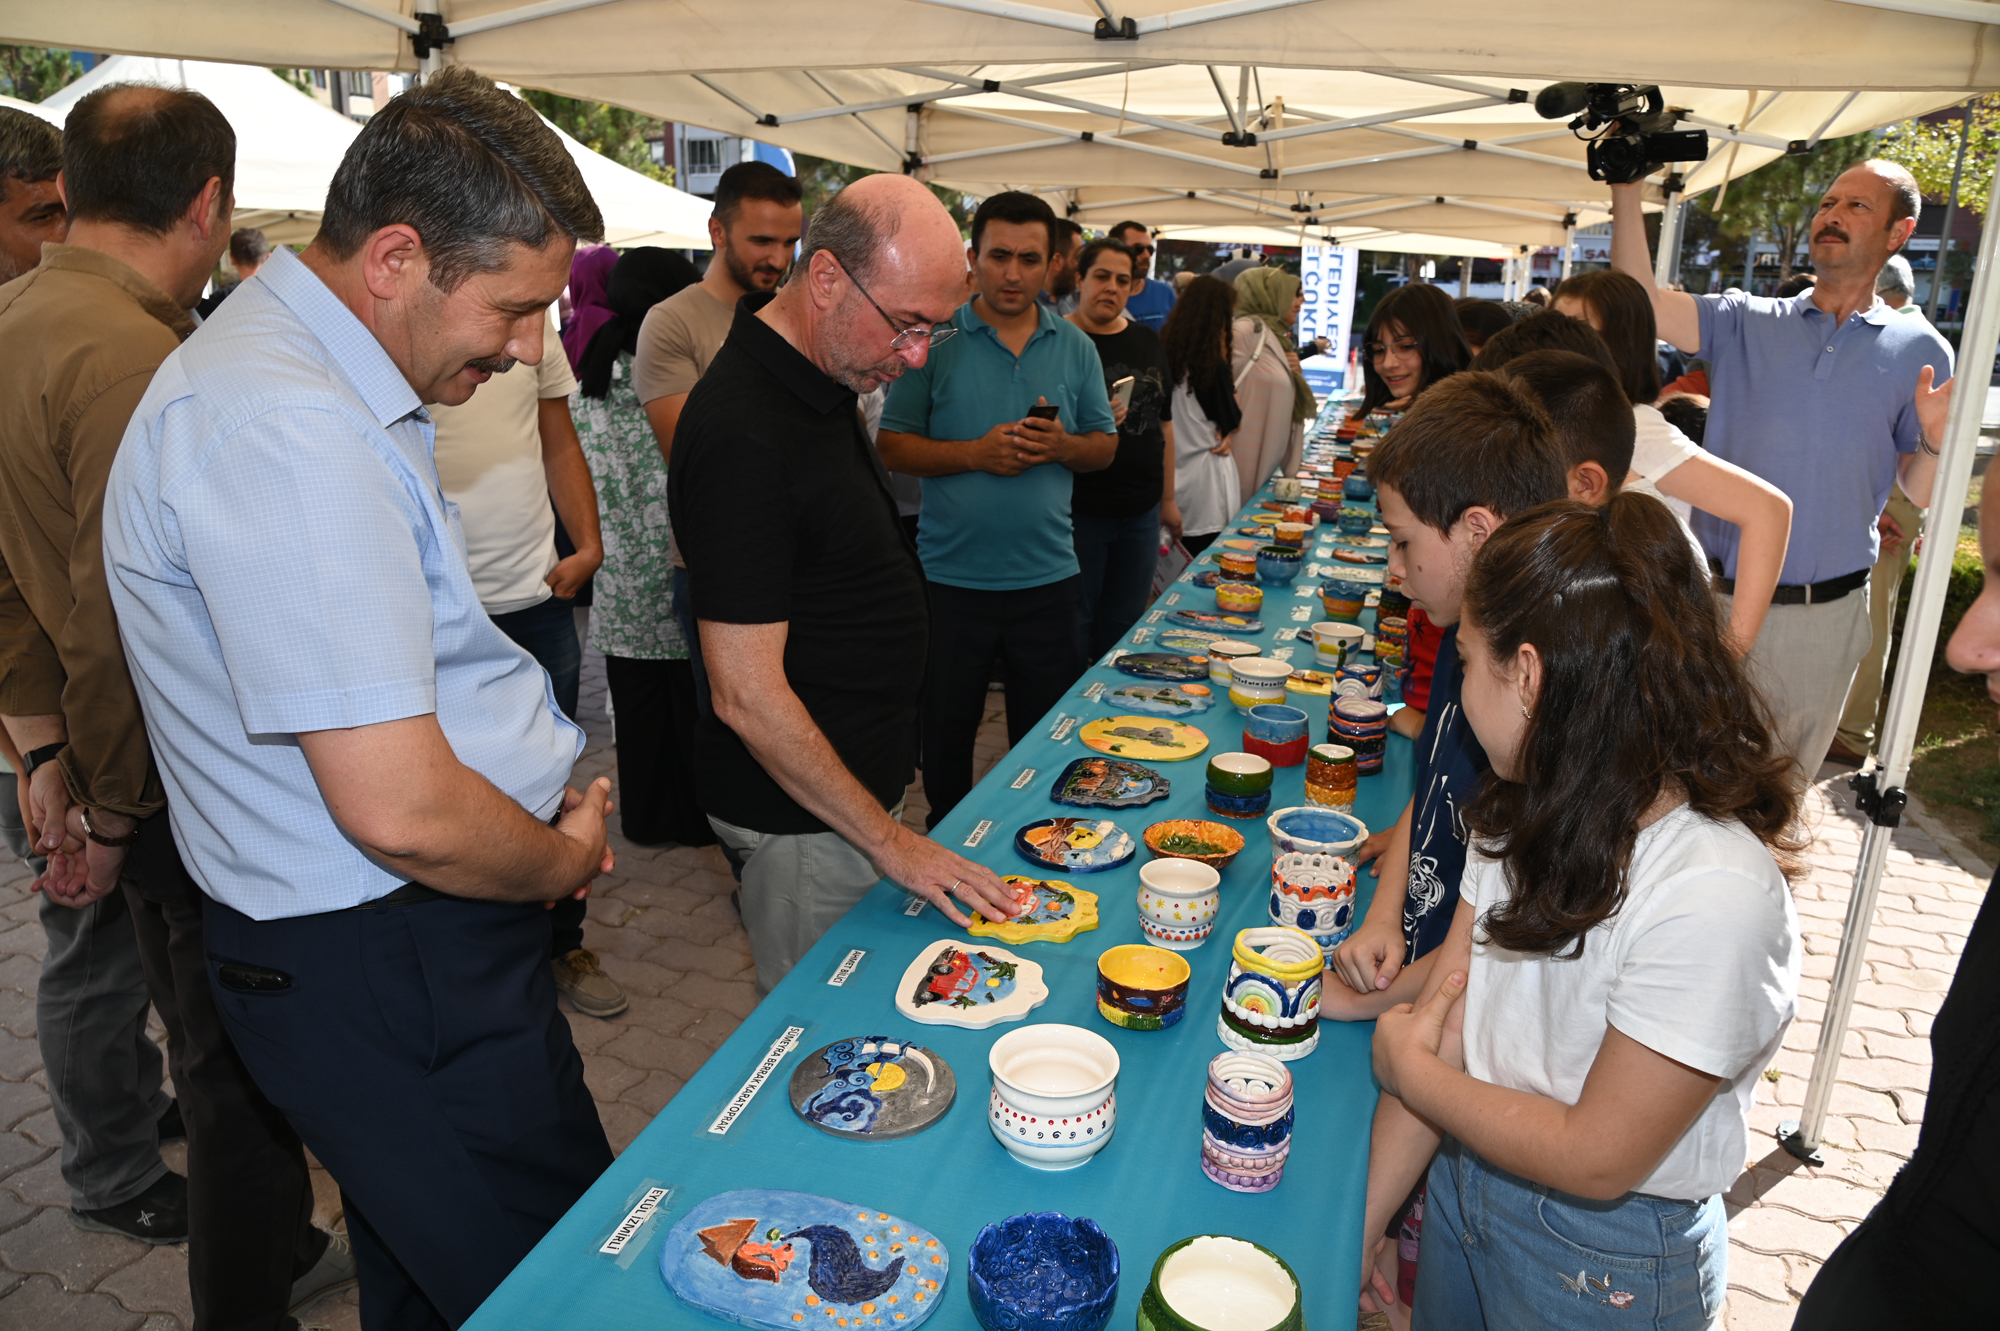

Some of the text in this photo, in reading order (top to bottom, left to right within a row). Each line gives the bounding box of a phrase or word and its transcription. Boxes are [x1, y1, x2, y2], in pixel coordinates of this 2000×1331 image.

[844, 950, 862, 969] AHMET
[714, 1027, 800, 1131] SÜMEYRA BERRAK KARATOPRAK
[606, 1189, 663, 1251] EYLÜL İZMİRLİ
